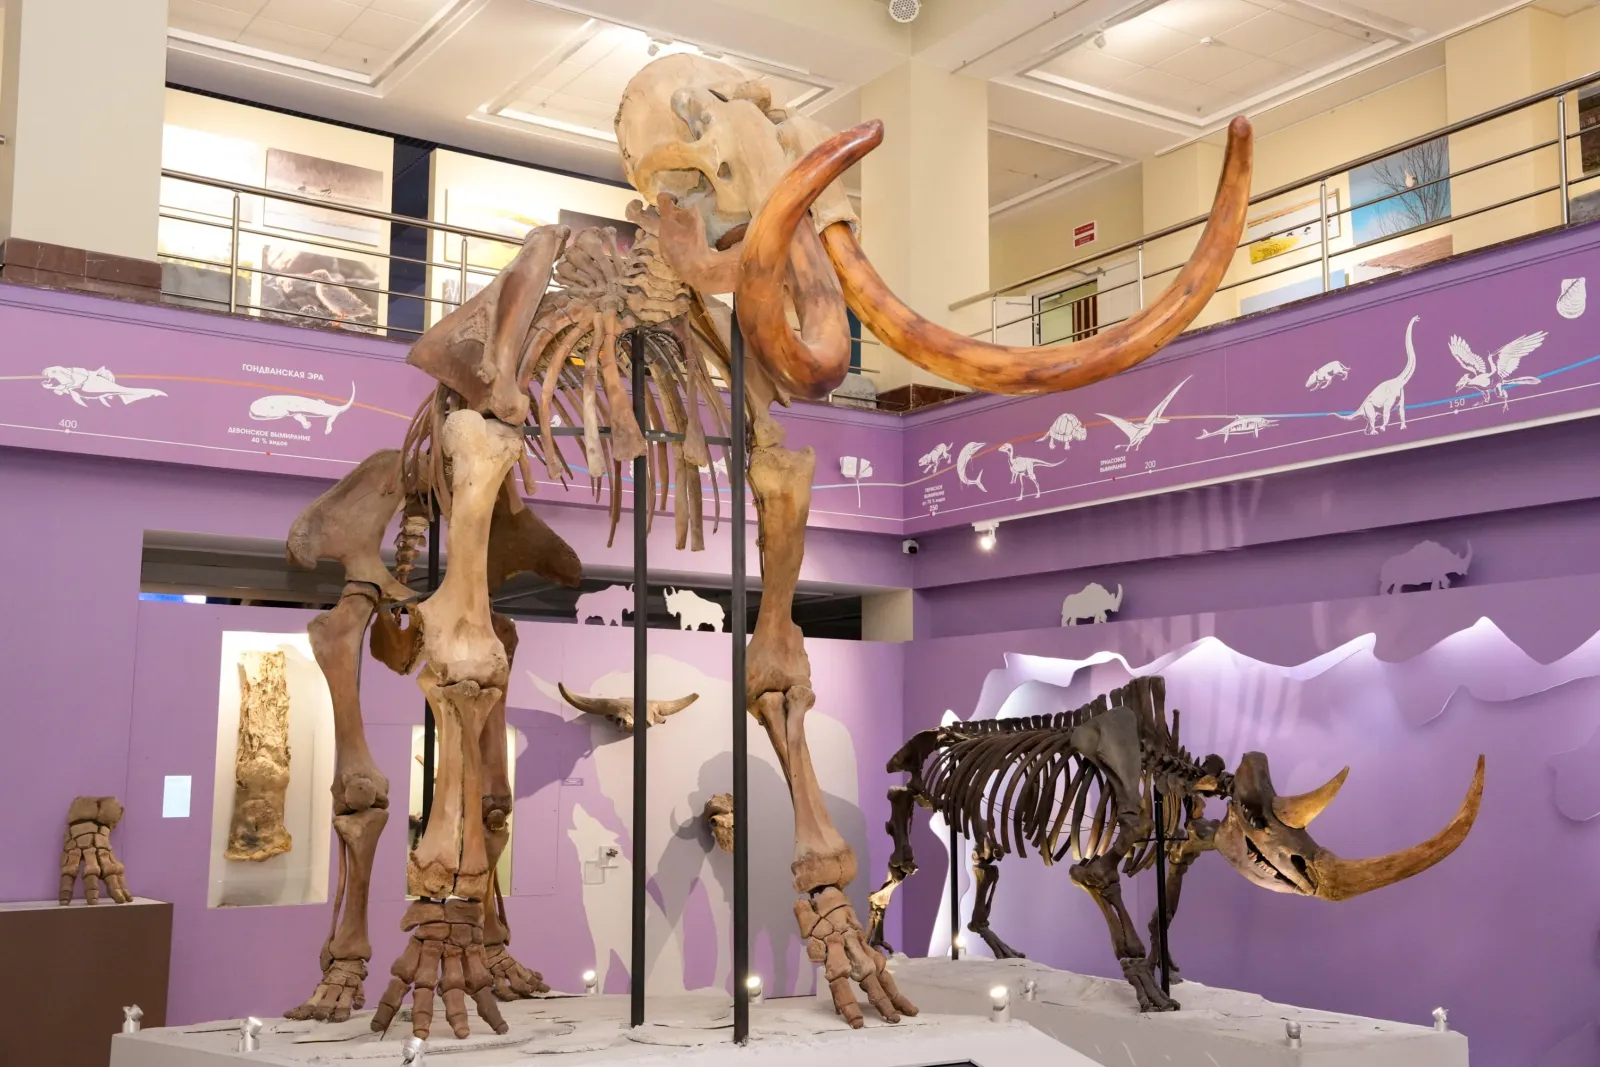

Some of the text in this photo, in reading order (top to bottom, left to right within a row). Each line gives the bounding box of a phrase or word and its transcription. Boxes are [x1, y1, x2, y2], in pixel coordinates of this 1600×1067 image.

[242, 363, 324, 381] ГОНДВАНСКАЯ ЭРА
[1449, 397, 1465, 409] 150
[58, 419, 78, 429] 400
[227, 426, 311, 442] ДЕВОНСКОЕ ВЫМИРАНИЕ
[1144, 460, 1156, 470] 200
